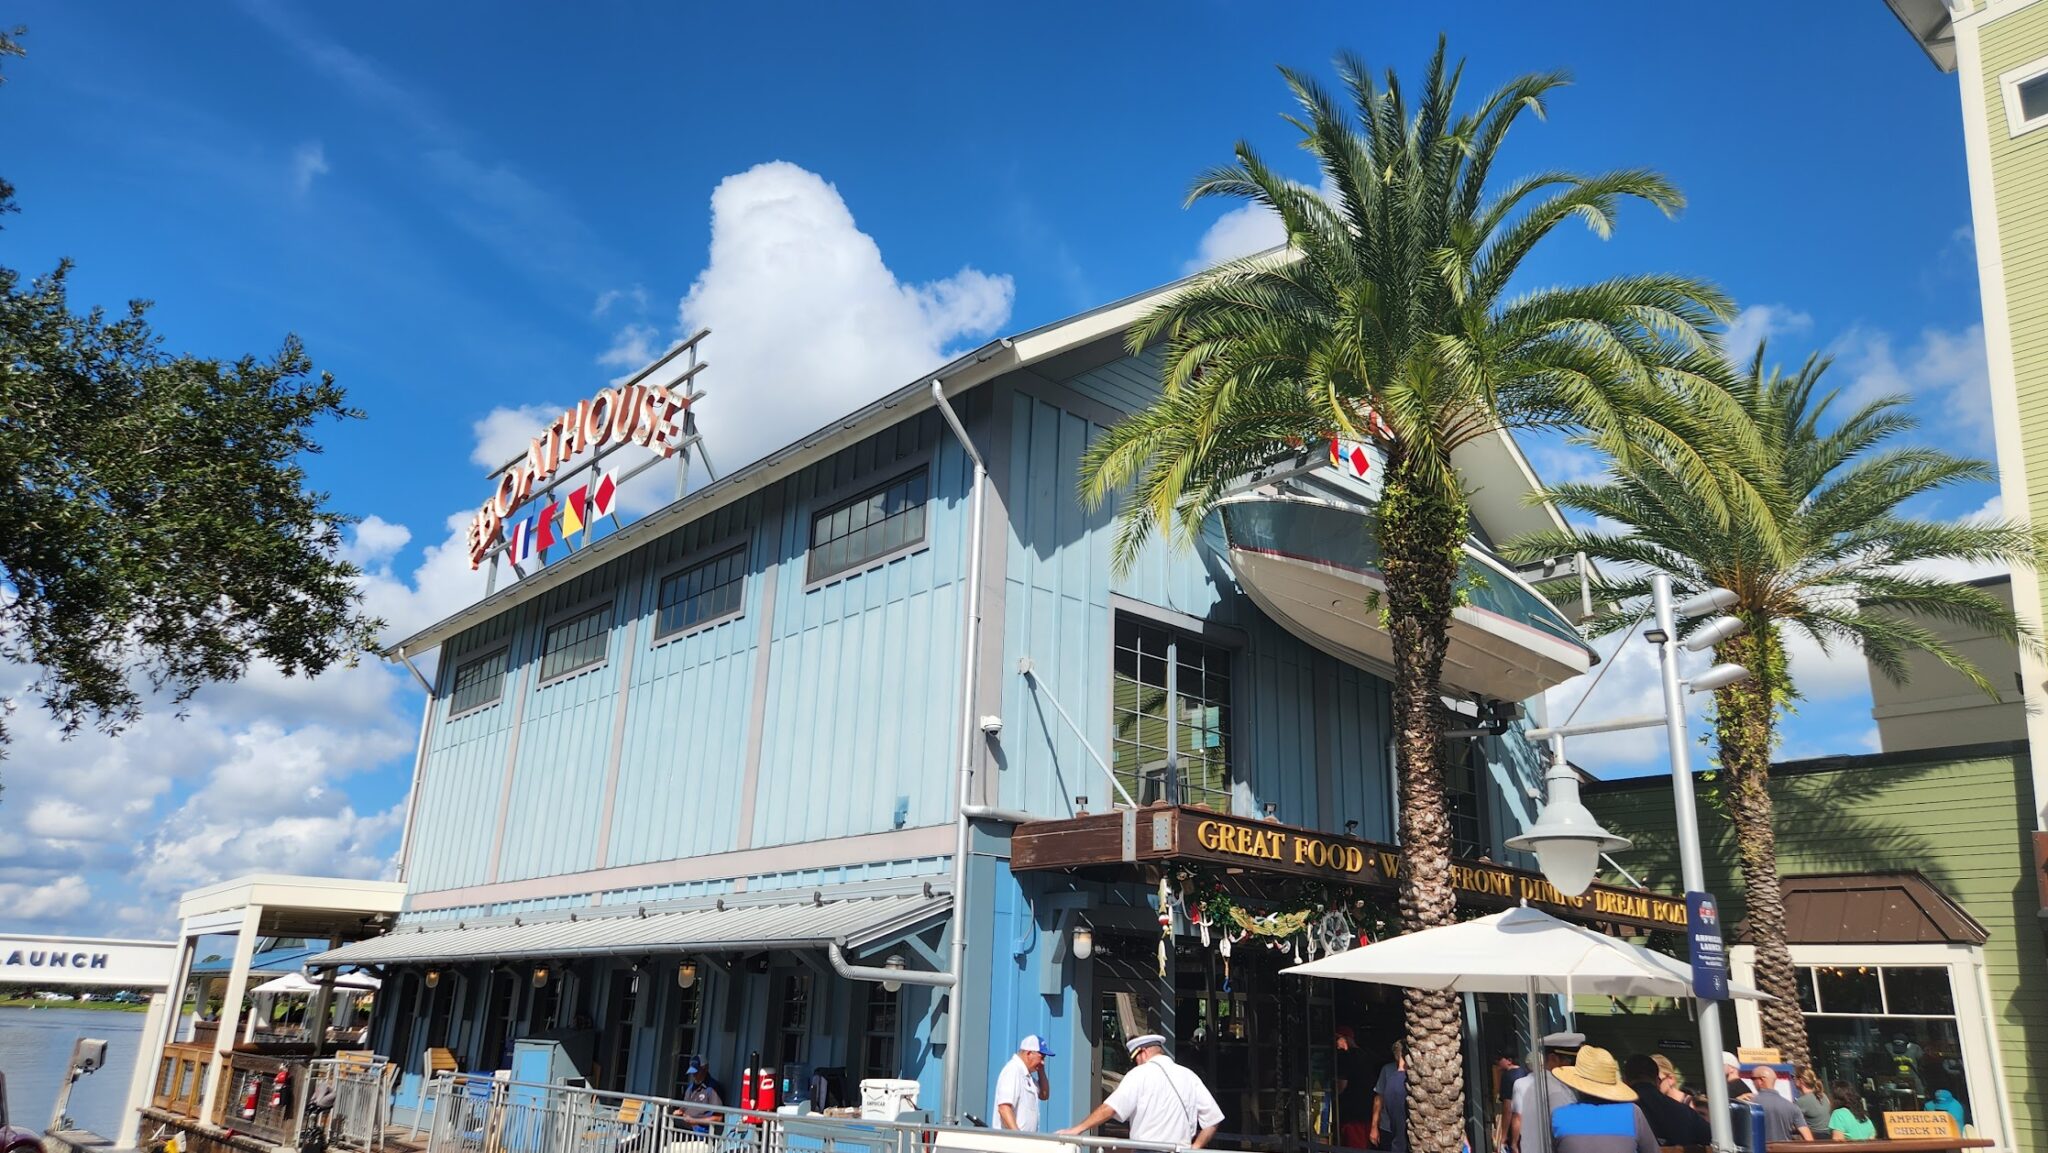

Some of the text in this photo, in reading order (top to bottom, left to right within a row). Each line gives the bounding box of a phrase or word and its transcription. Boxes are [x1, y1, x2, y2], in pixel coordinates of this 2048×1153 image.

[478, 384, 690, 552] BOATHOUSE
[1197, 820, 1285, 860] GREAT
[1294, 836, 1363, 873] FOOD
[1379, 852, 1514, 897] WFRONT
[1594, 890, 1650, 919] DREAM
[0, 950, 109, 969] AUNCH
[1889, 1114, 1948, 1123] AMPHICAR
[1894, 1126, 1946, 1135] CHECK IN
